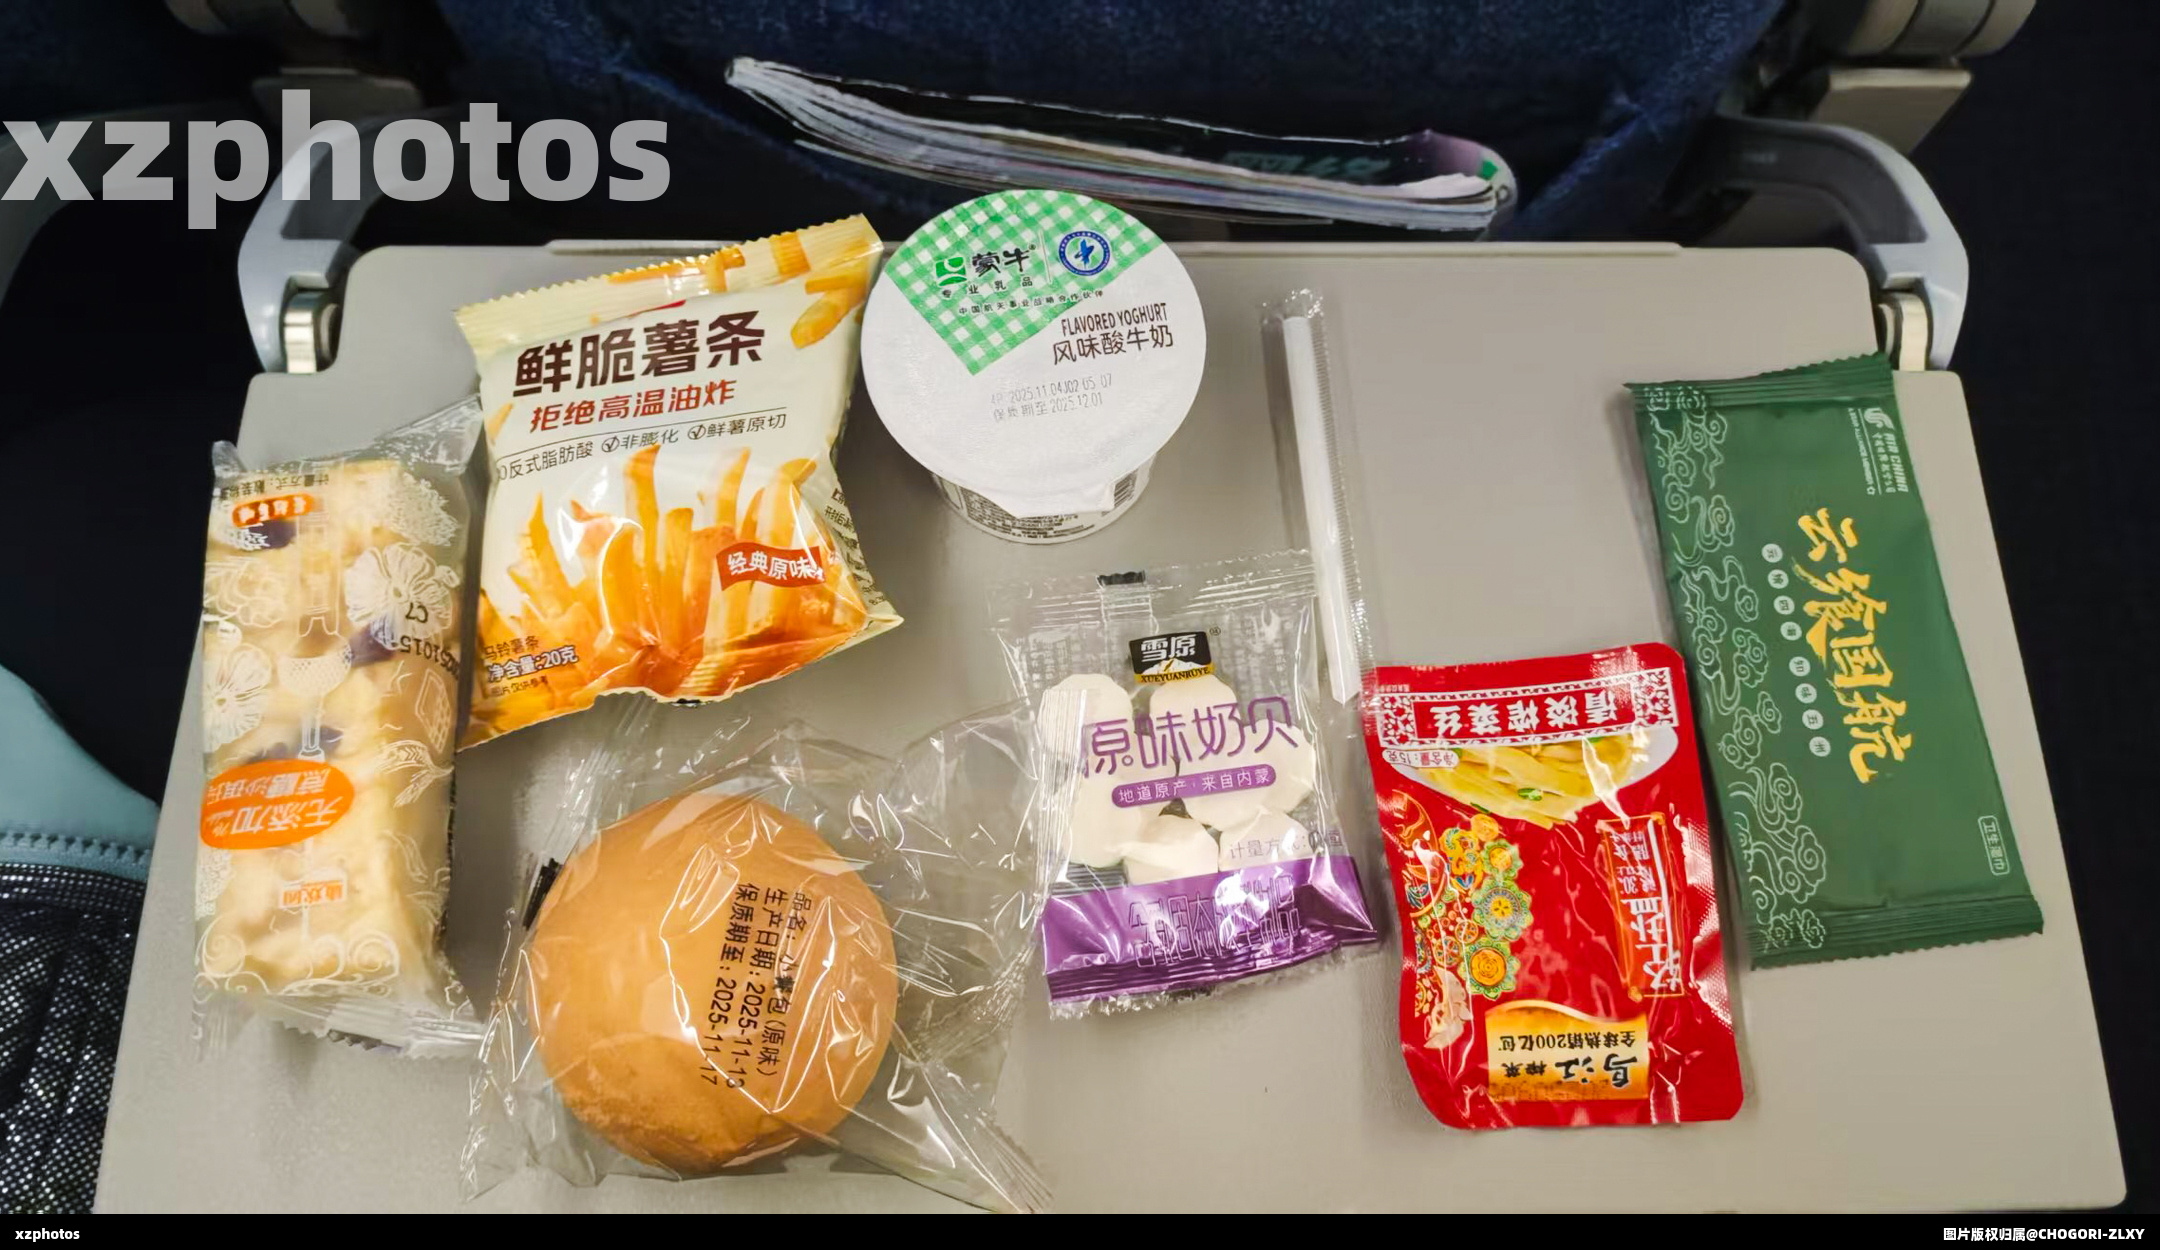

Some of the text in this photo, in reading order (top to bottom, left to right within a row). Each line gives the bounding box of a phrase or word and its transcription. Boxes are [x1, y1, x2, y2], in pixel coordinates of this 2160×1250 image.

[972, 247, 1030, 277] 蒙牛
[942, 276, 1033, 299] 专业乳品
[1061, 303, 1167, 337] FLAVORED YOGHURT
[512, 310, 765, 398] 鲜脆薯条
[1052, 325, 1174, 365] 风味酸牛奶
[530, 379, 738, 433] 拒绝高温油炸
[620, 428, 679, 451] 非膨化
[705, 413, 787, 440] 鲜薯原切
[1884, 432, 1909, 493] AIR CHINA
[725, 551, 818, 580] 经典原味
[1140, 634, 1198, 663] 雪原
[1792, 507, 1914, 784] 云飨国航
[1140, 666, 1211, 684] XUEYUANRUYE
[1430, 689, 1617, 738] 清淡榨菜丝
[1082, 695, 1300, 779] 原味奶贝
[230, 796, 343, 836] 无添加
[1620, 894, 1682, 992] 轻盐
[1498, 1030, 1637, 1053] 全球热销200亿包
[1499, 1053, 1638, 1088] 乌江 榨菜
